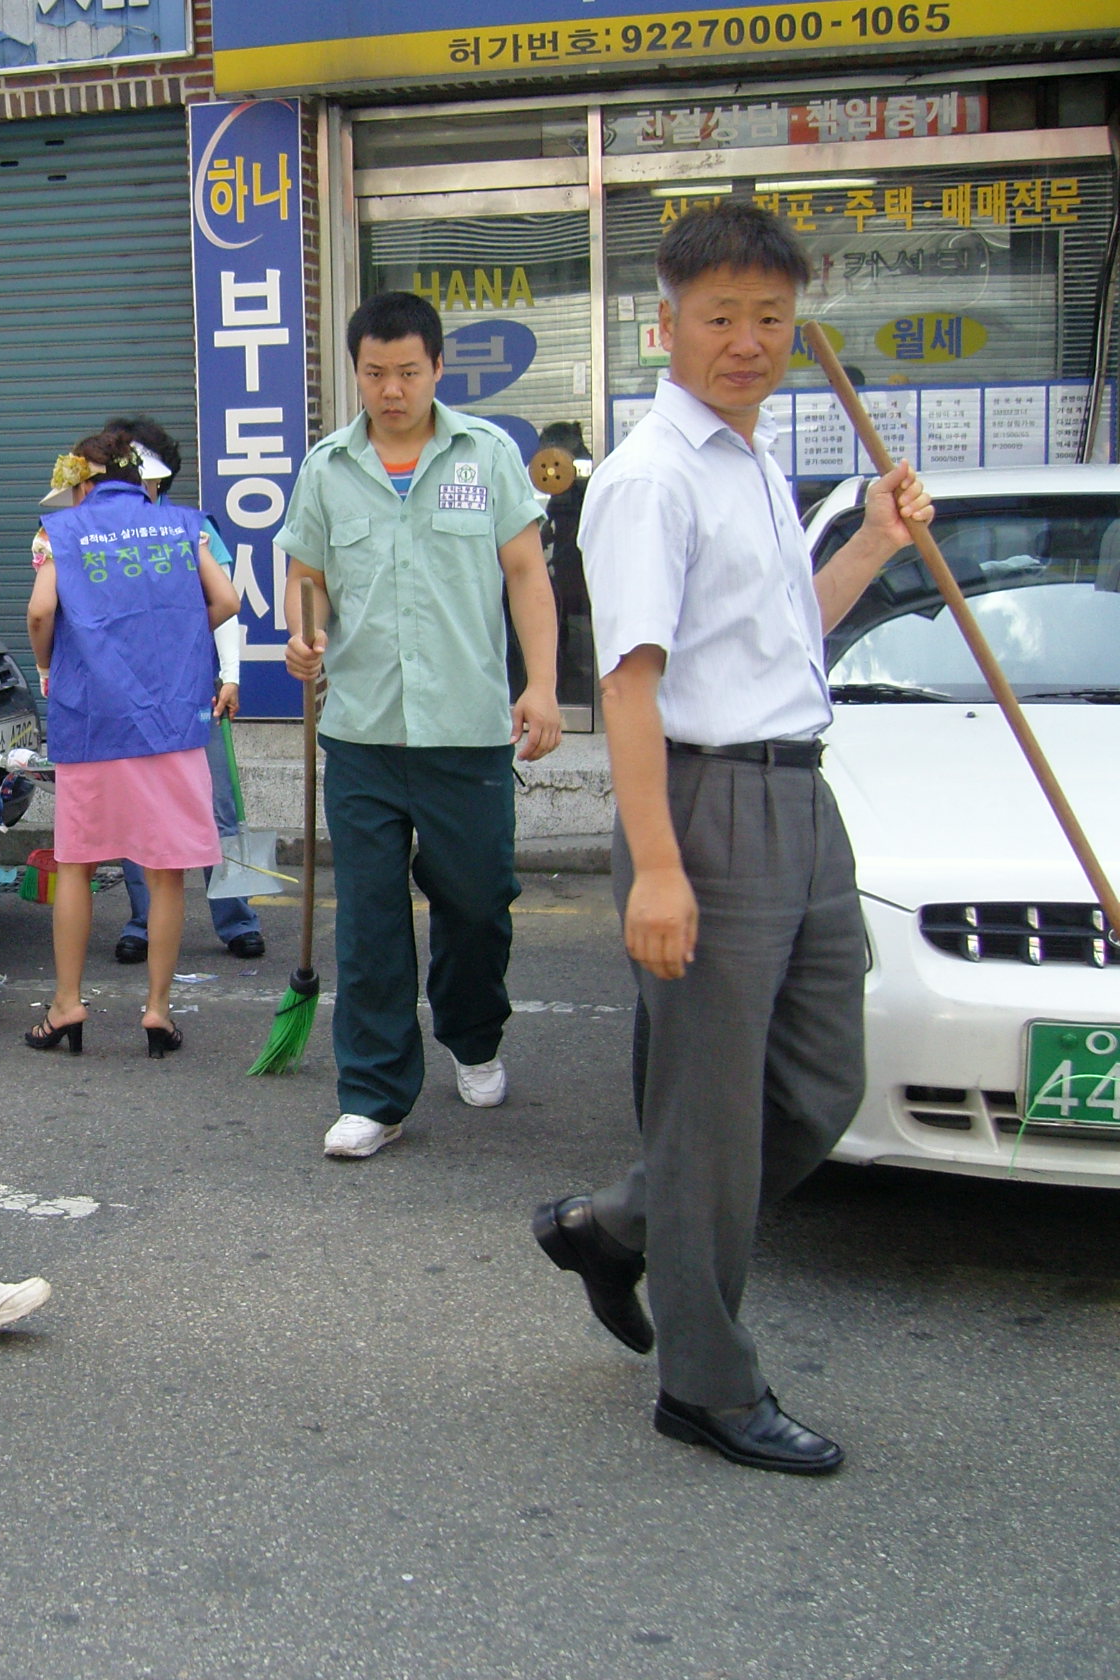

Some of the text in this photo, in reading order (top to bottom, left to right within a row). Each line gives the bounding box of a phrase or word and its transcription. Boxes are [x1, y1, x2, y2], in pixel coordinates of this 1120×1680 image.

[207, 152, 291, 223] 하나
[413, 267, 535, 310] HANA
[444, 335, 513, 396] 부
[892, 316, 962, 360] 월세
[214, 268, 291, 662] 부동산
